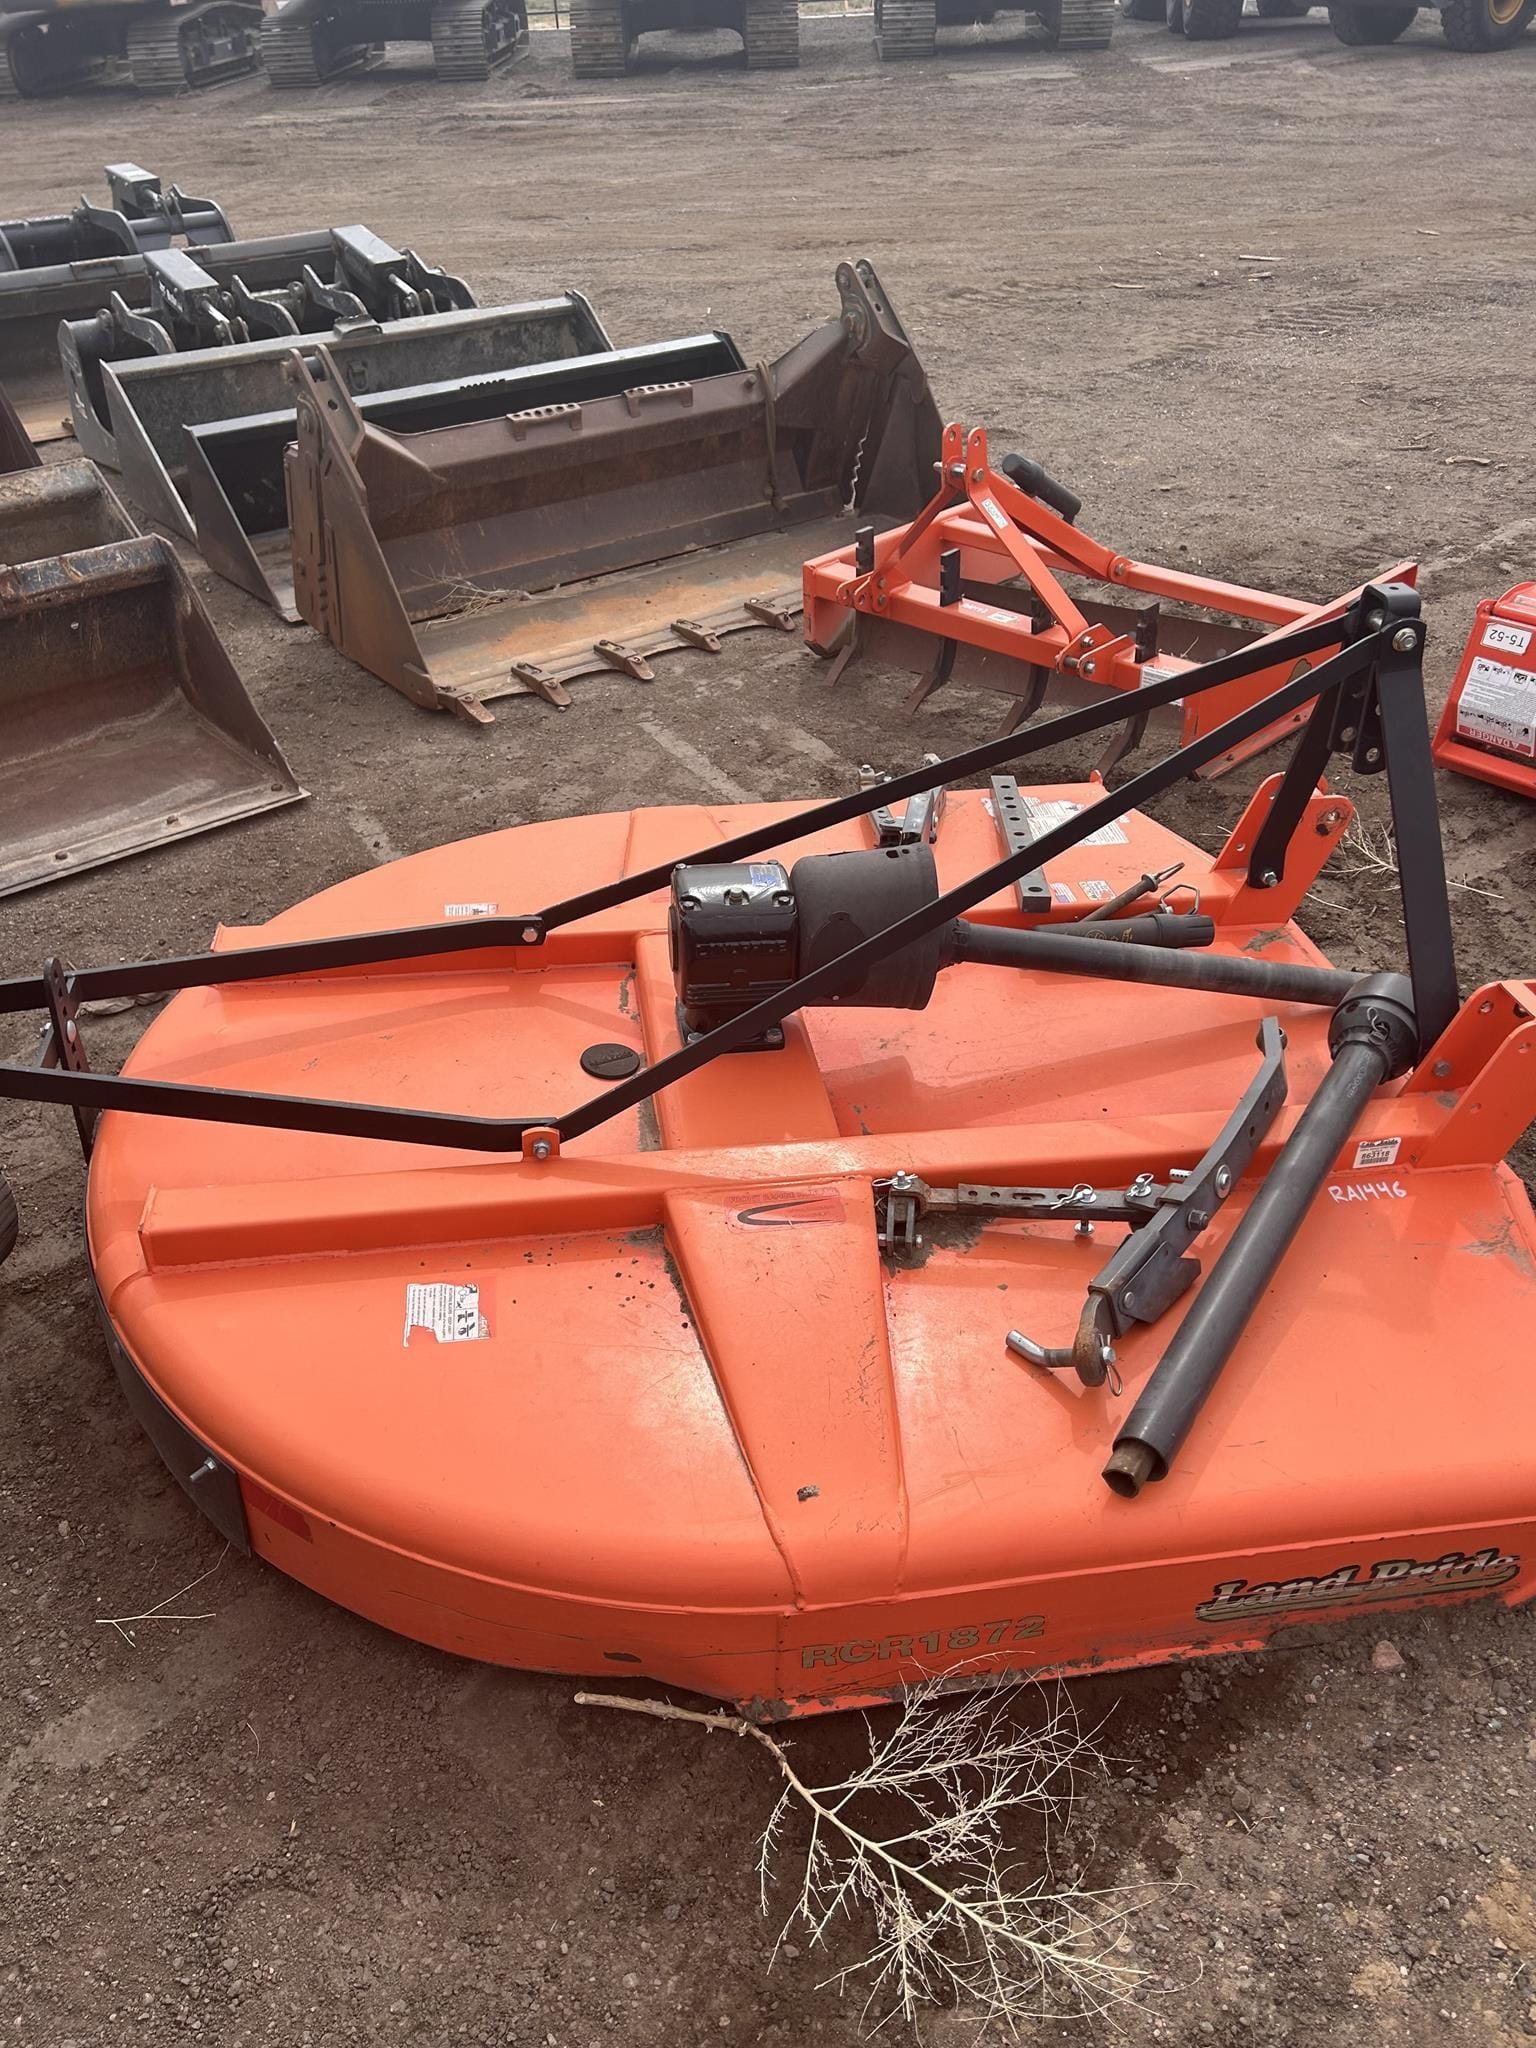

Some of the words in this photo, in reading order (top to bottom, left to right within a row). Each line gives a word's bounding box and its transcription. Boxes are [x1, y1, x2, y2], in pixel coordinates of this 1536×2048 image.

[1489, 628, 1524, 648] T5-52
[1469, 728, 1512, 749] DANGER
[1327, 1180, 1408, 1203] RA1446
[1207, 1565, 1361, 1611] Land
[801, 1615, 1047, 1669] RCR1872
